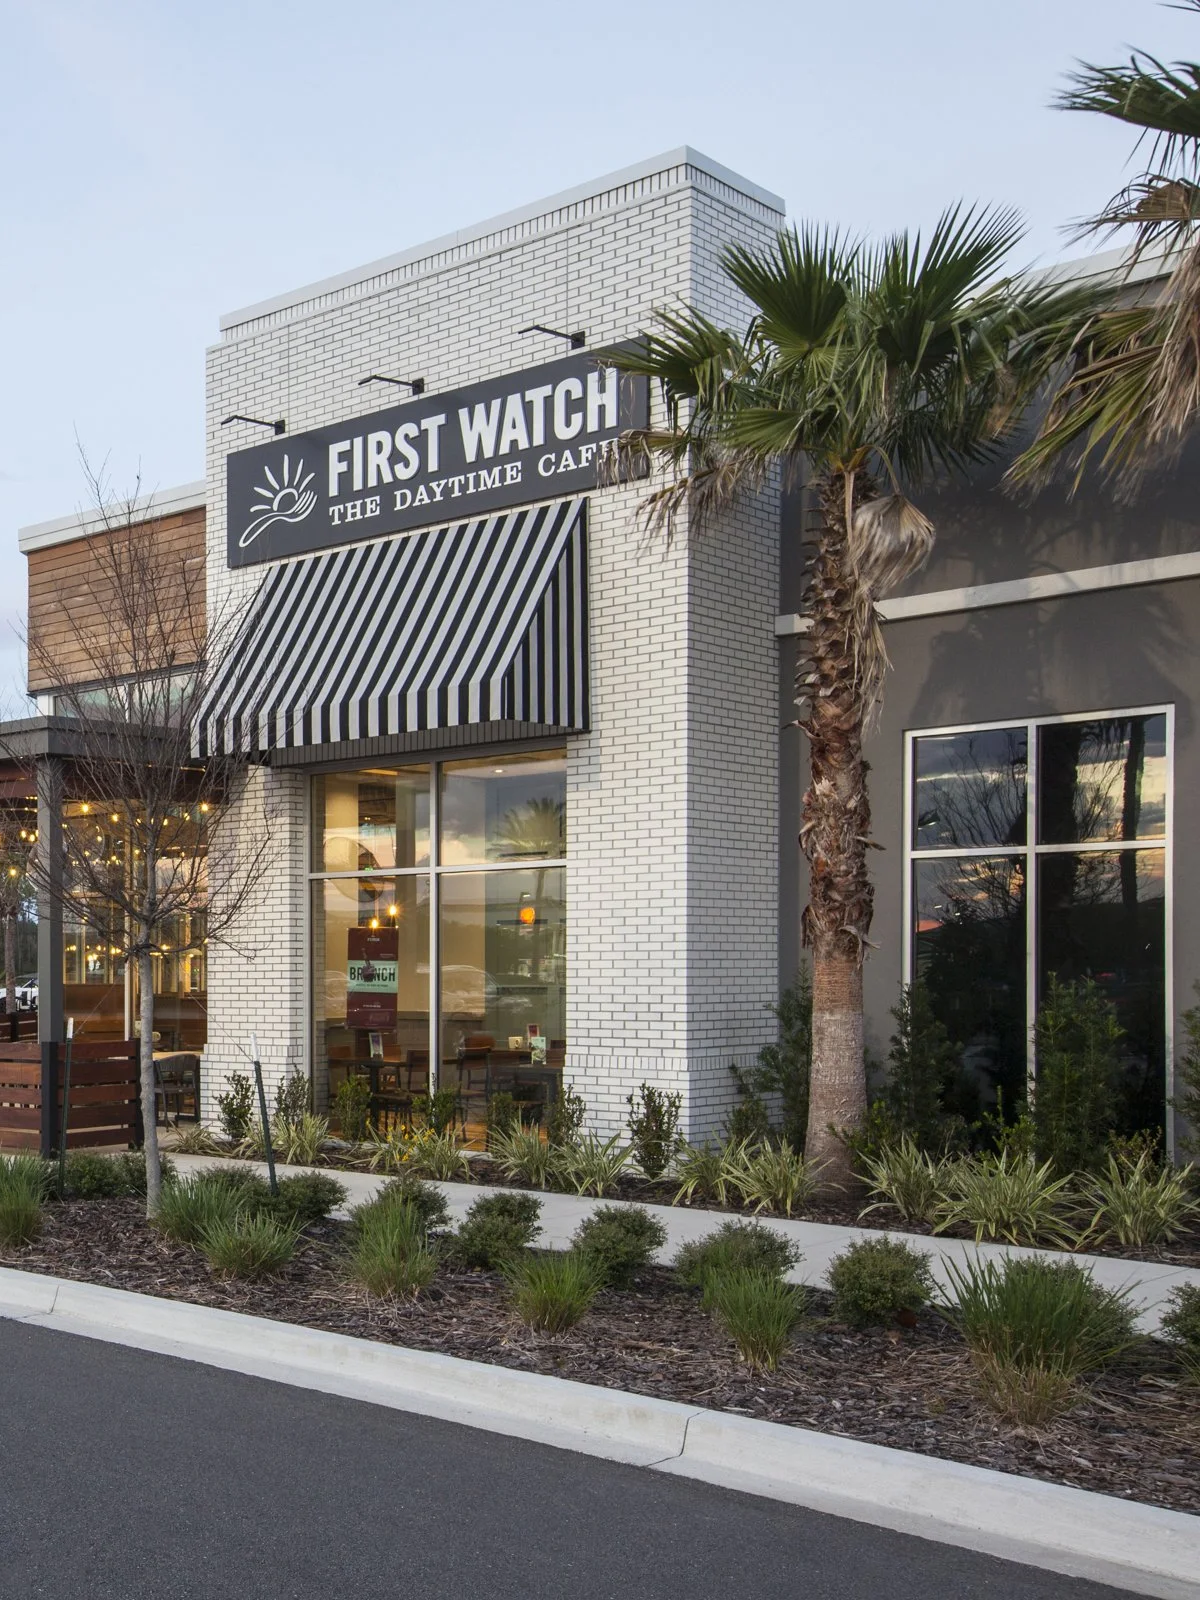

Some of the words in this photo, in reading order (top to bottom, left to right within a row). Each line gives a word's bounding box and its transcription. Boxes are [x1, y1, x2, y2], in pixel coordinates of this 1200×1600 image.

[329, 413, 448, 498] FIRST
[458, 367, 618, 464] WATCH
[329, 495, 381, 526] THE
[394, 461, 522, 511] DAYTIME
[349, 966, 396, 982] BRNCH
